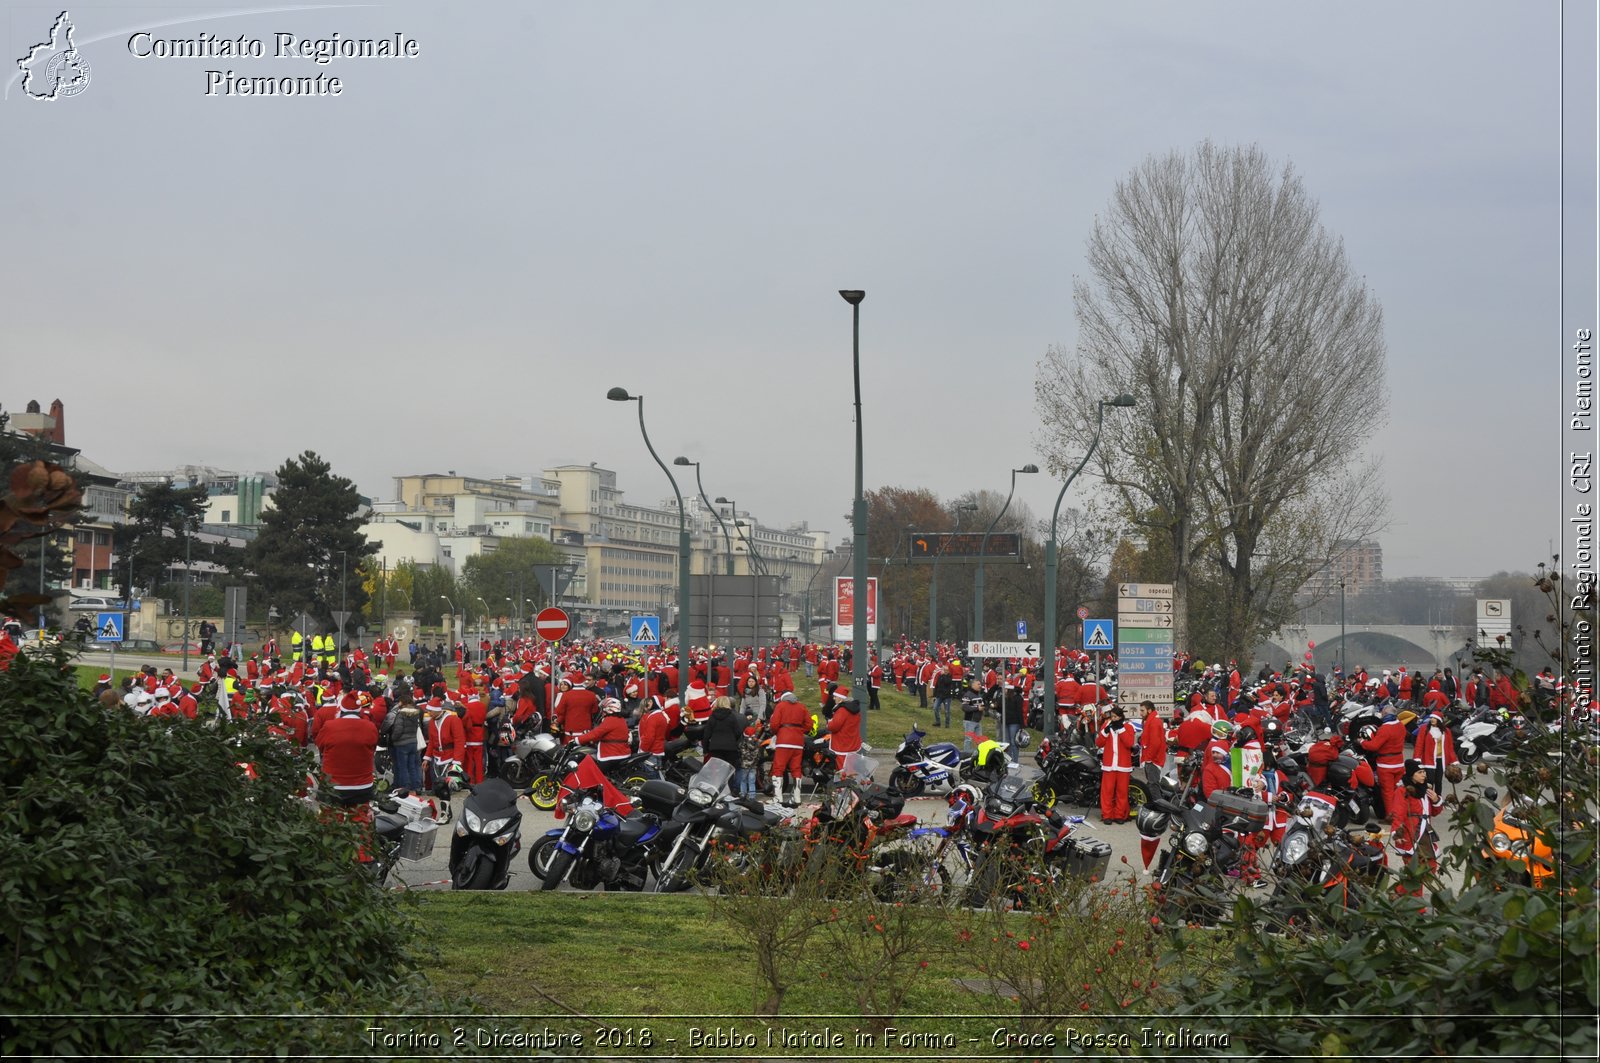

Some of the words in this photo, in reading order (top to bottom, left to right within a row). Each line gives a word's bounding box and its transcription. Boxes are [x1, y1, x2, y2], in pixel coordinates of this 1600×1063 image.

[1120, 647, 1145, 655] AOSTA
[1119, 662, 1145, 670] MILANO
[1140, 692, 1173, 700] fiera-oval
